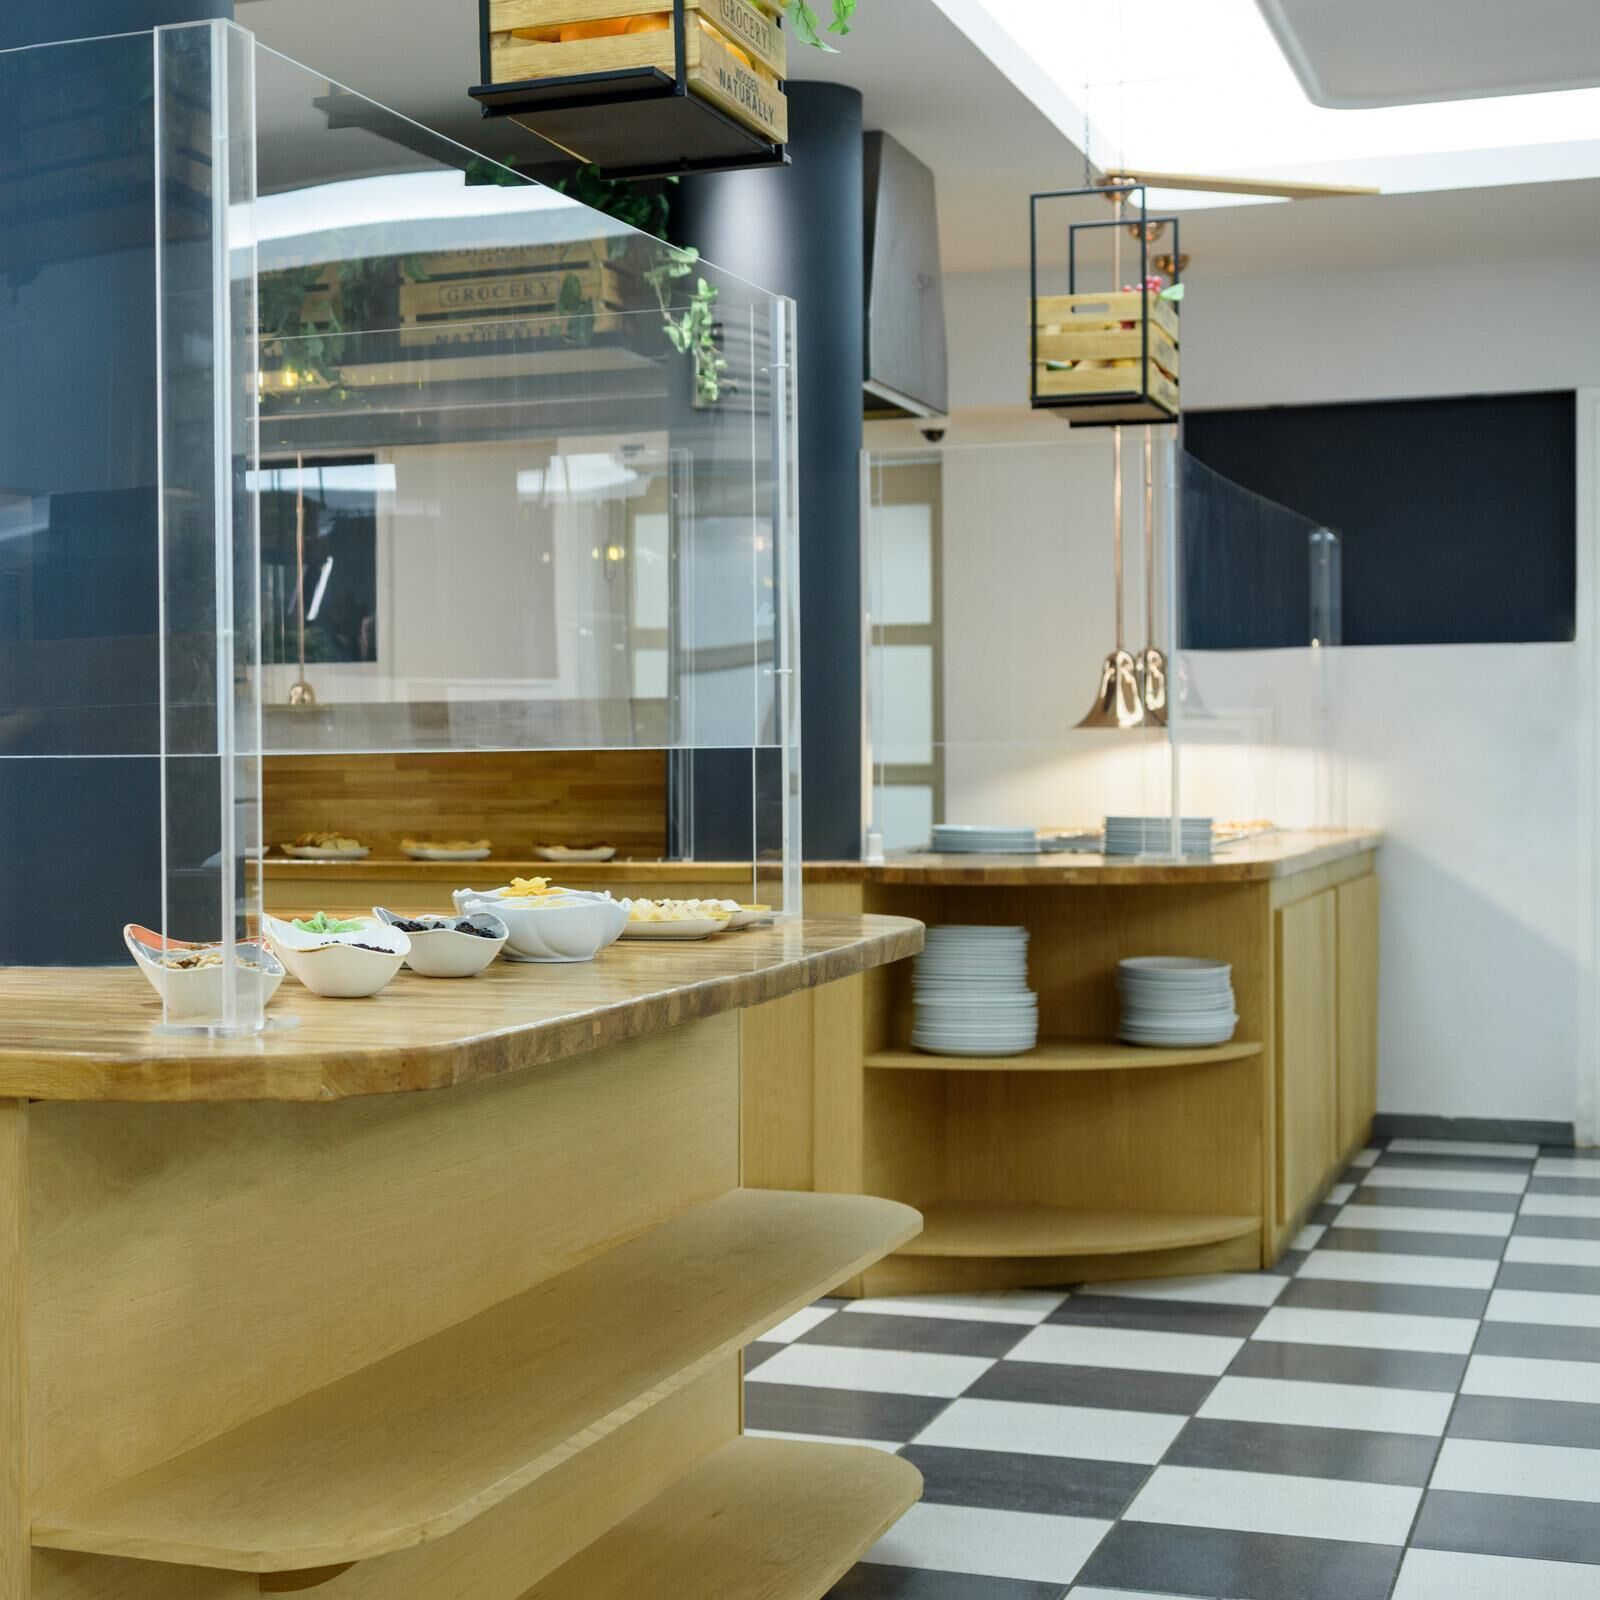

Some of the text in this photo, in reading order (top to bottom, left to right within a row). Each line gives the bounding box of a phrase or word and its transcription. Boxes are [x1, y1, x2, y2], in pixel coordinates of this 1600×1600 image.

[722, 0, 767, 49] GROCERY
[719, 67, 774, 125] NATURALLY
[447, 281, 551, 303] GROCERY
